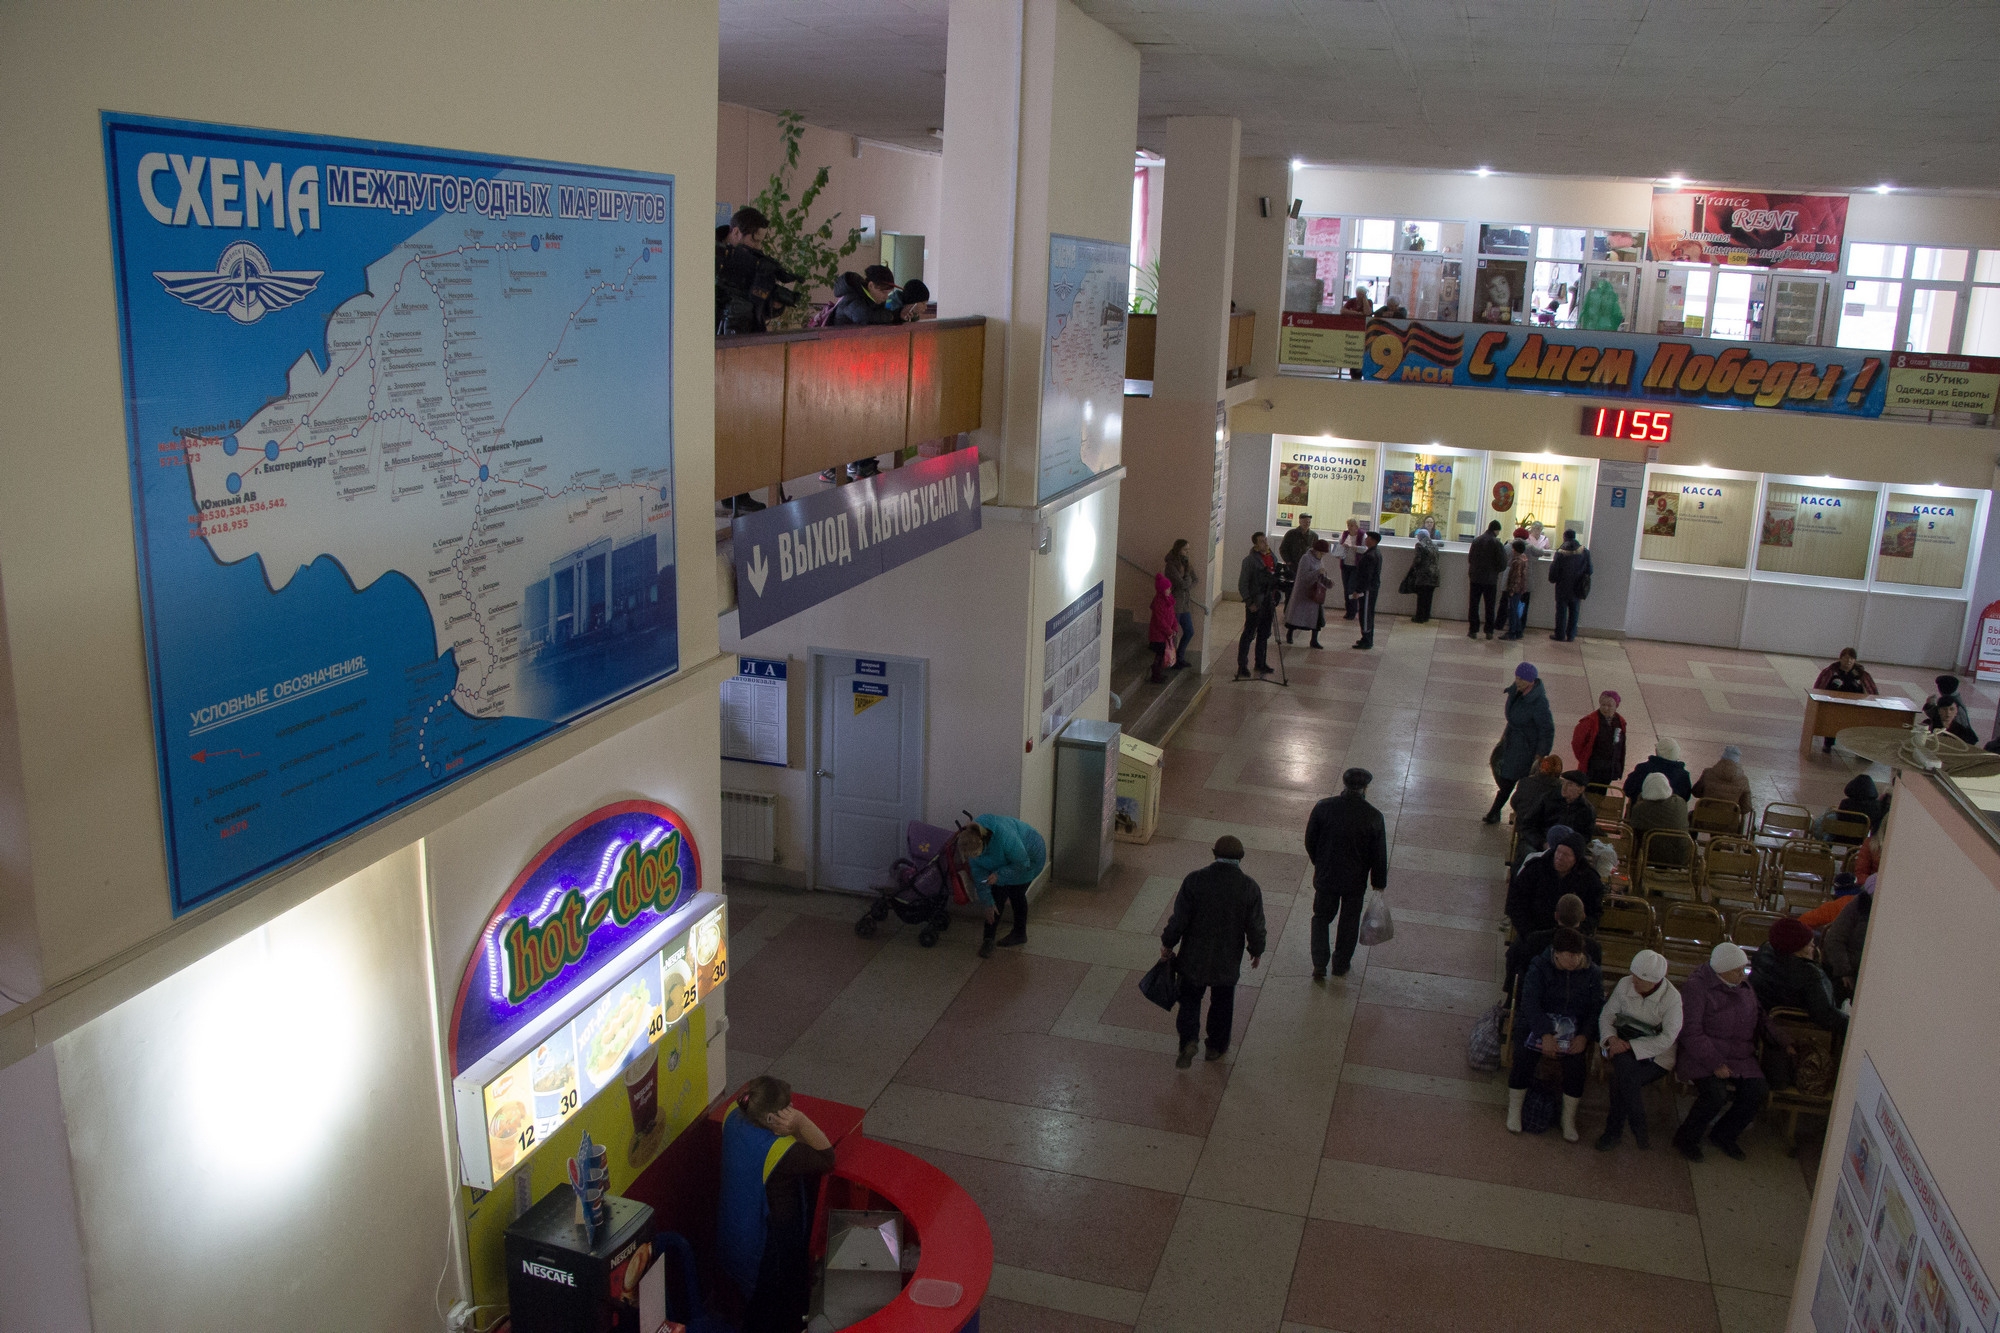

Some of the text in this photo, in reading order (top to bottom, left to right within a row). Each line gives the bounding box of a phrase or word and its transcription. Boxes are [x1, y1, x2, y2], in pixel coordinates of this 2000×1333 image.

[137, 152, 667, 237] СХЕМА МЕЖДУГОРОДНЫХ МАРШРУТОВ
[1695, 194, 1749, 207] France
[1732, 208, 1798, 231] RENI
[1677, 229, 1730, 243] Элитная
[1784, 233, 1837, 245] PARFUM
[1759, 246, 1836, 266] парфюмерия
[1287, 315, 1294, 326] 1
[1369, 333, 1405, 381] 9
[1467, 331, 1507, 379] С
[1506, 333, 1635, 387] Днем
[1897, 355, 1906, 367] 8
[1401, 366, 1454, 385] мая
[1920, 372, 1969, 385] «БУтик»
[1896, 384, 1935, 395] Одежда
[1952, 388, 1990, 399] Европы
[1913, 398, 1948, 406] низким
[1952, 400, 1984, 409] ценам
[173, 419, 242, 436] Северный АВ
[263, 456, 327, 474] Екатеринбург
[1293, 454, 1367, 466] СПРАВОЧНОЕ
[1298, 464, 1359, 474] АВТОВОКЗАЛА
[1415, 463, 1452, 474] КАССА
[1331, 473, 1365, 482] 39-99-73
[1522, 472, 1560, 483] КАССА
[1536, 487, 1542, 495] 2
[1683, 486, 1722, 497] КАССА
[201, 491, 257, 511] Южный АВ
[1801, 496, 1841, 507] КАССА
[1814, 512, 1821, 520] 4
[1912, 505, 1955, 517] КАССА
[778, 475, 959, 582] ВЫХОД К АВТОБУСАМ
[1928, 521, 1935, 529] 5
[190, 688, 269, 727] УСЛОВНЫЕ
[273, 655, 367, 702] ОБОЗНАЧЕНИЯ:
[207, 769, 268, 799] Златогорово
[713, 960, 726, 982] 30
[683, 985, 697, 1009] 25
[649, 1014, 663, 1036] 40
[561, 1089, 578, 1115] 30
[518, 1125, 536, 1151] 12
[1895, 1136, 1939, 1224] ДЕЙСТВОВАТЬ
[1939, 1220, 1956, 1253] ПРИ
[1955, 1250, 1990, 1318] ПОЖАРЕ
[522, 1260, 575, 1287] NESCAFÉ
